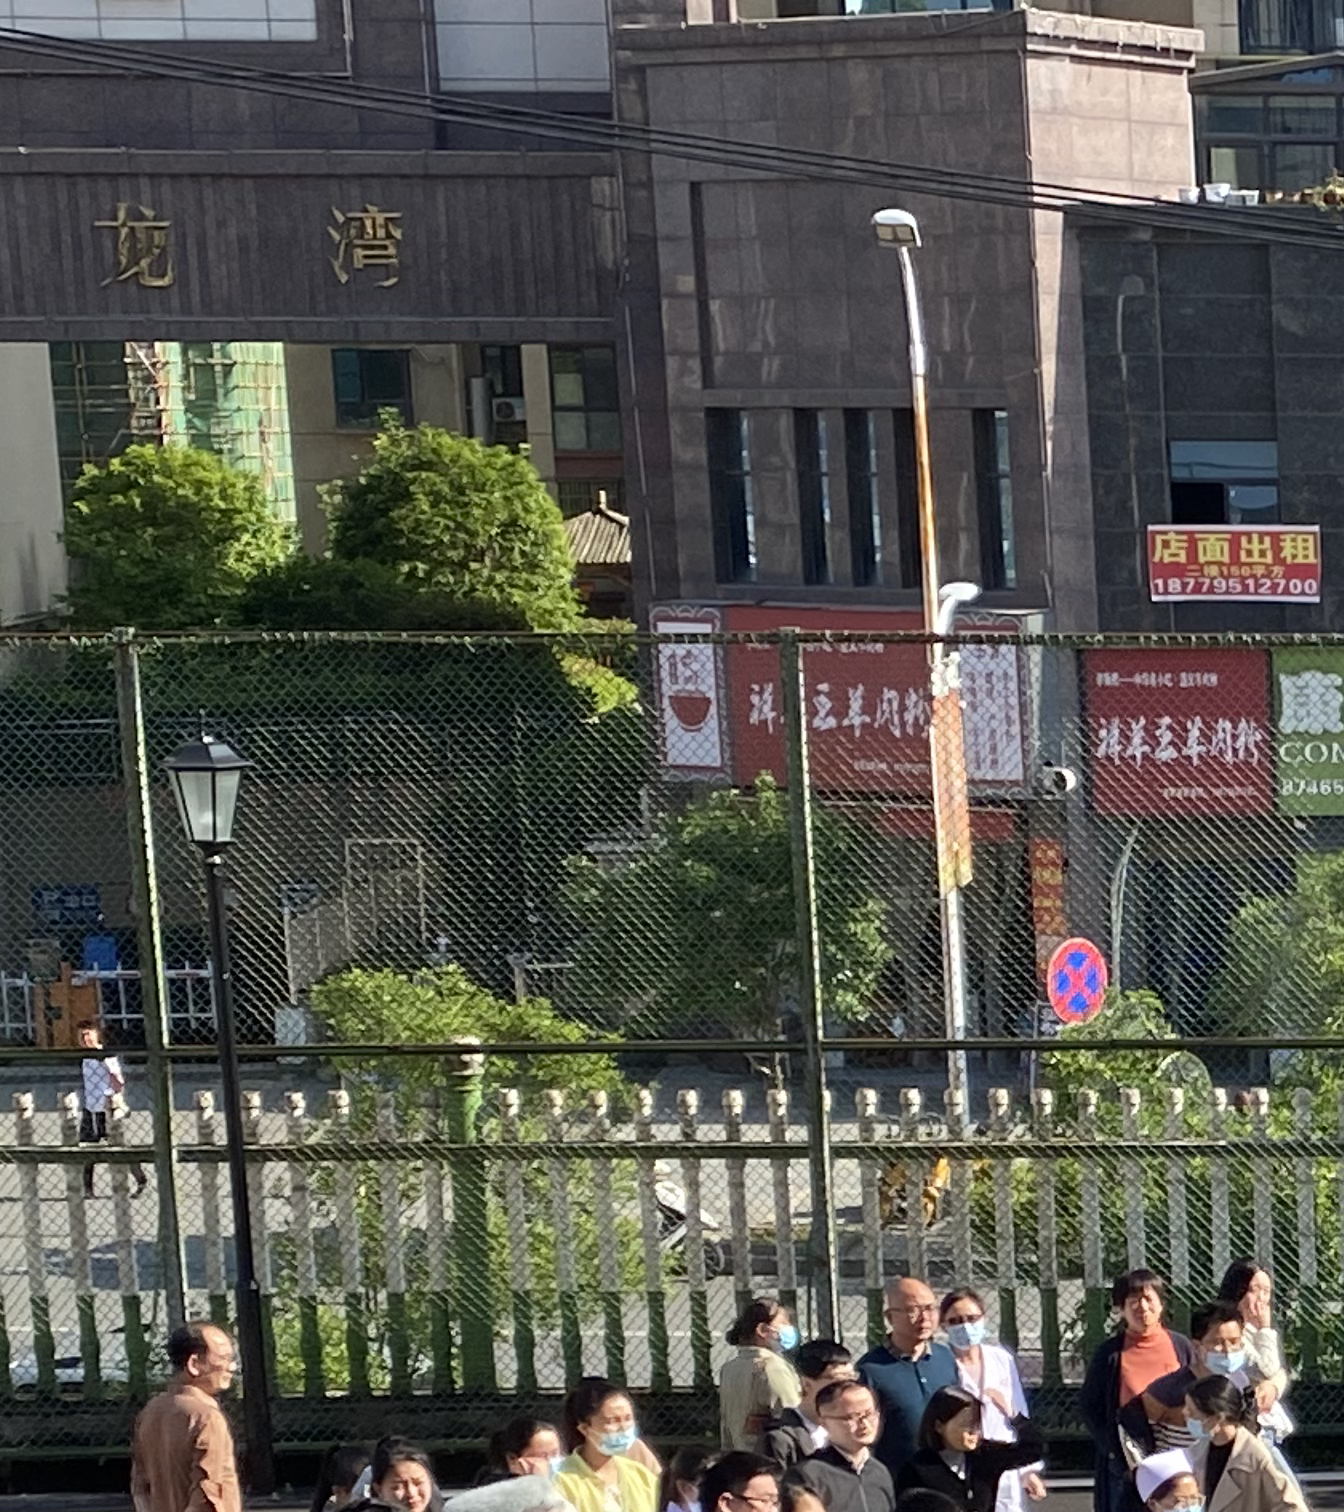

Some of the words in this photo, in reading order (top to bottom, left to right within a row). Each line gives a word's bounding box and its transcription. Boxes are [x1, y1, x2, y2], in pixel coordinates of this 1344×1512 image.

[93, 202, 403, 288] 龙湾
[1153, 531, 1318, 564] 店面出租
[1153, 577, 1318, 594] 18779512700
